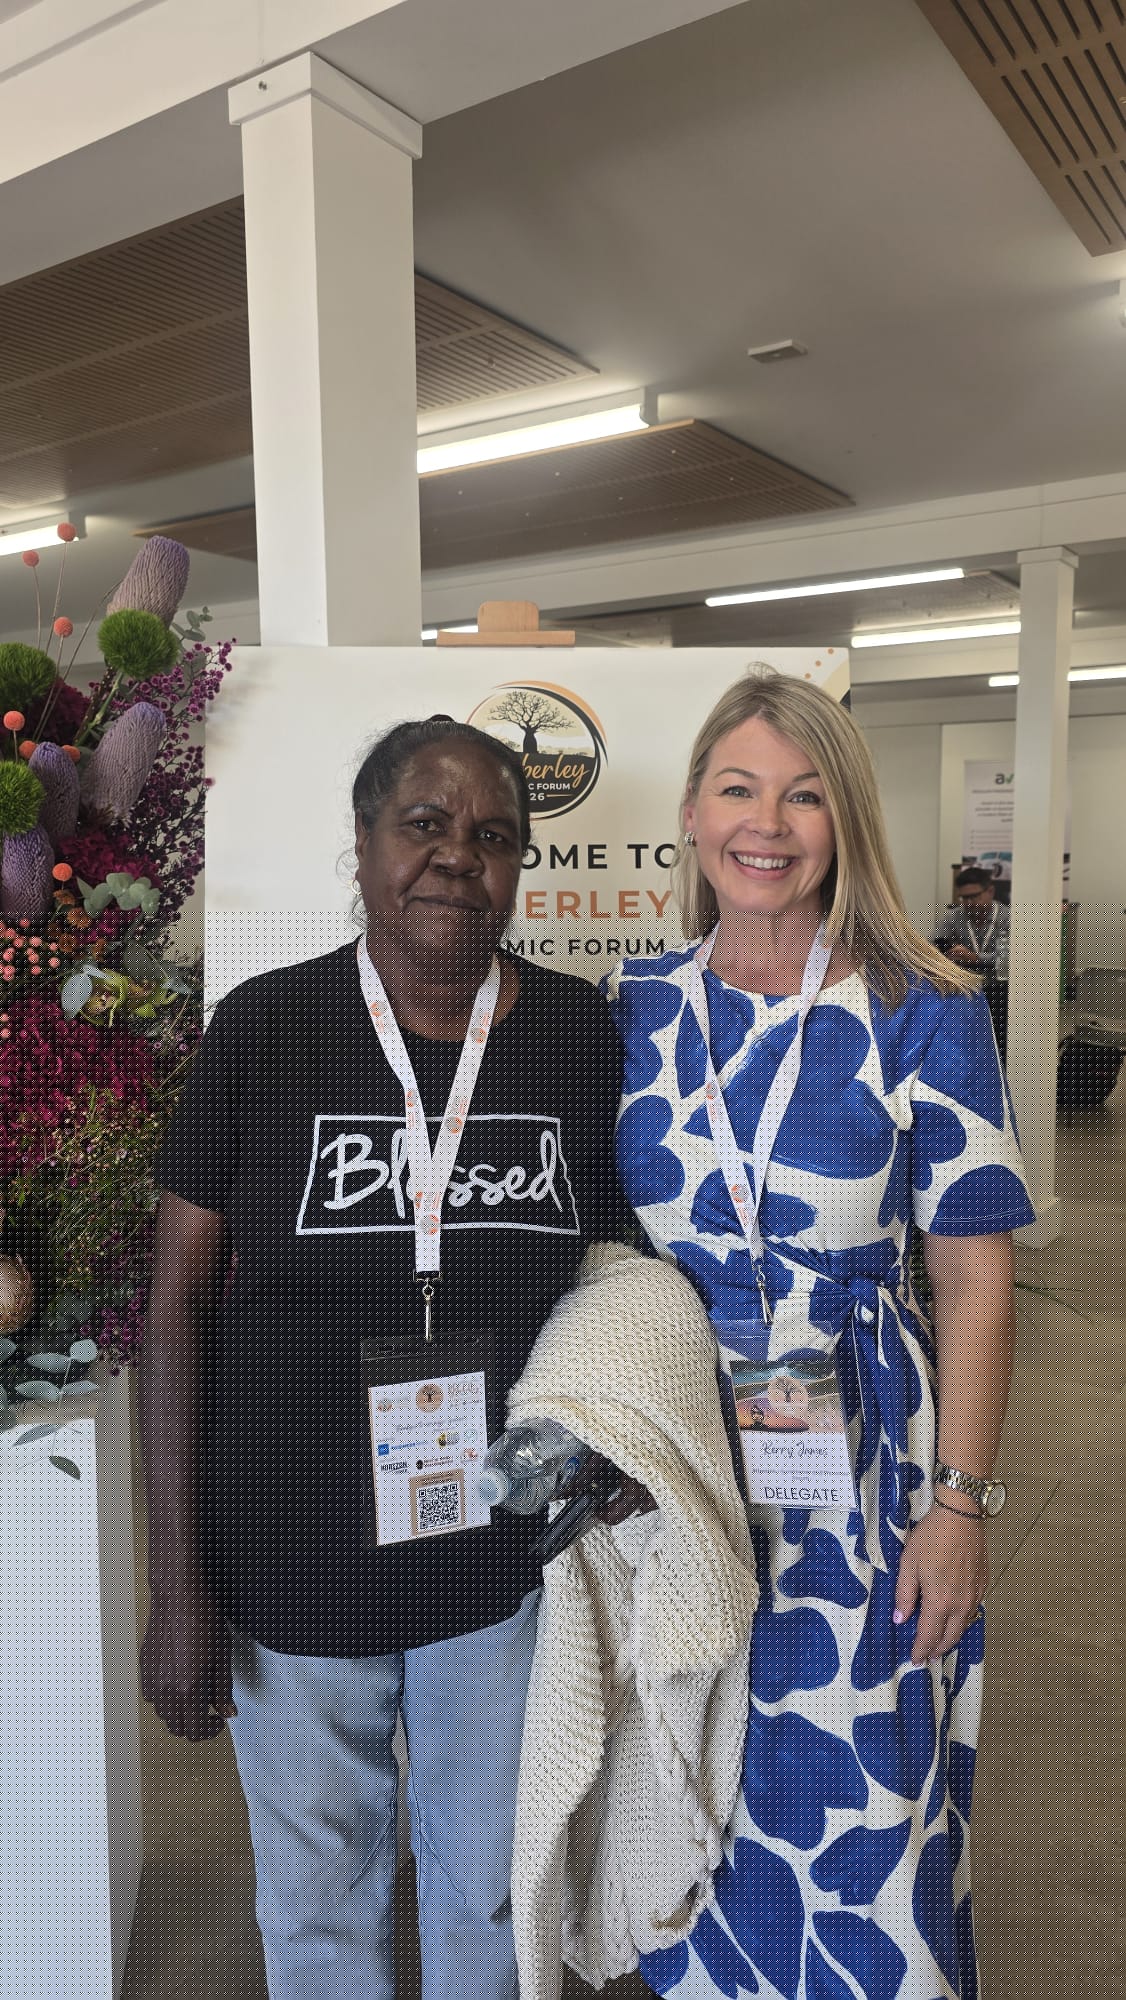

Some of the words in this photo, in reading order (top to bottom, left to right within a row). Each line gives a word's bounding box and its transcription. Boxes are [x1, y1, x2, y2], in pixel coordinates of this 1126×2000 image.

[529, 792, 545, 801] 26
[627, 843, 677, 870] TO
[513, 890, 673, 919] ERLEY
[506, 938, 554, 956] MIC
[568, 938, 665, 956] FORUM
[320, 1128, 563, 1220] Blssed
[764, 1486, 840, 1503] DELEGATE
